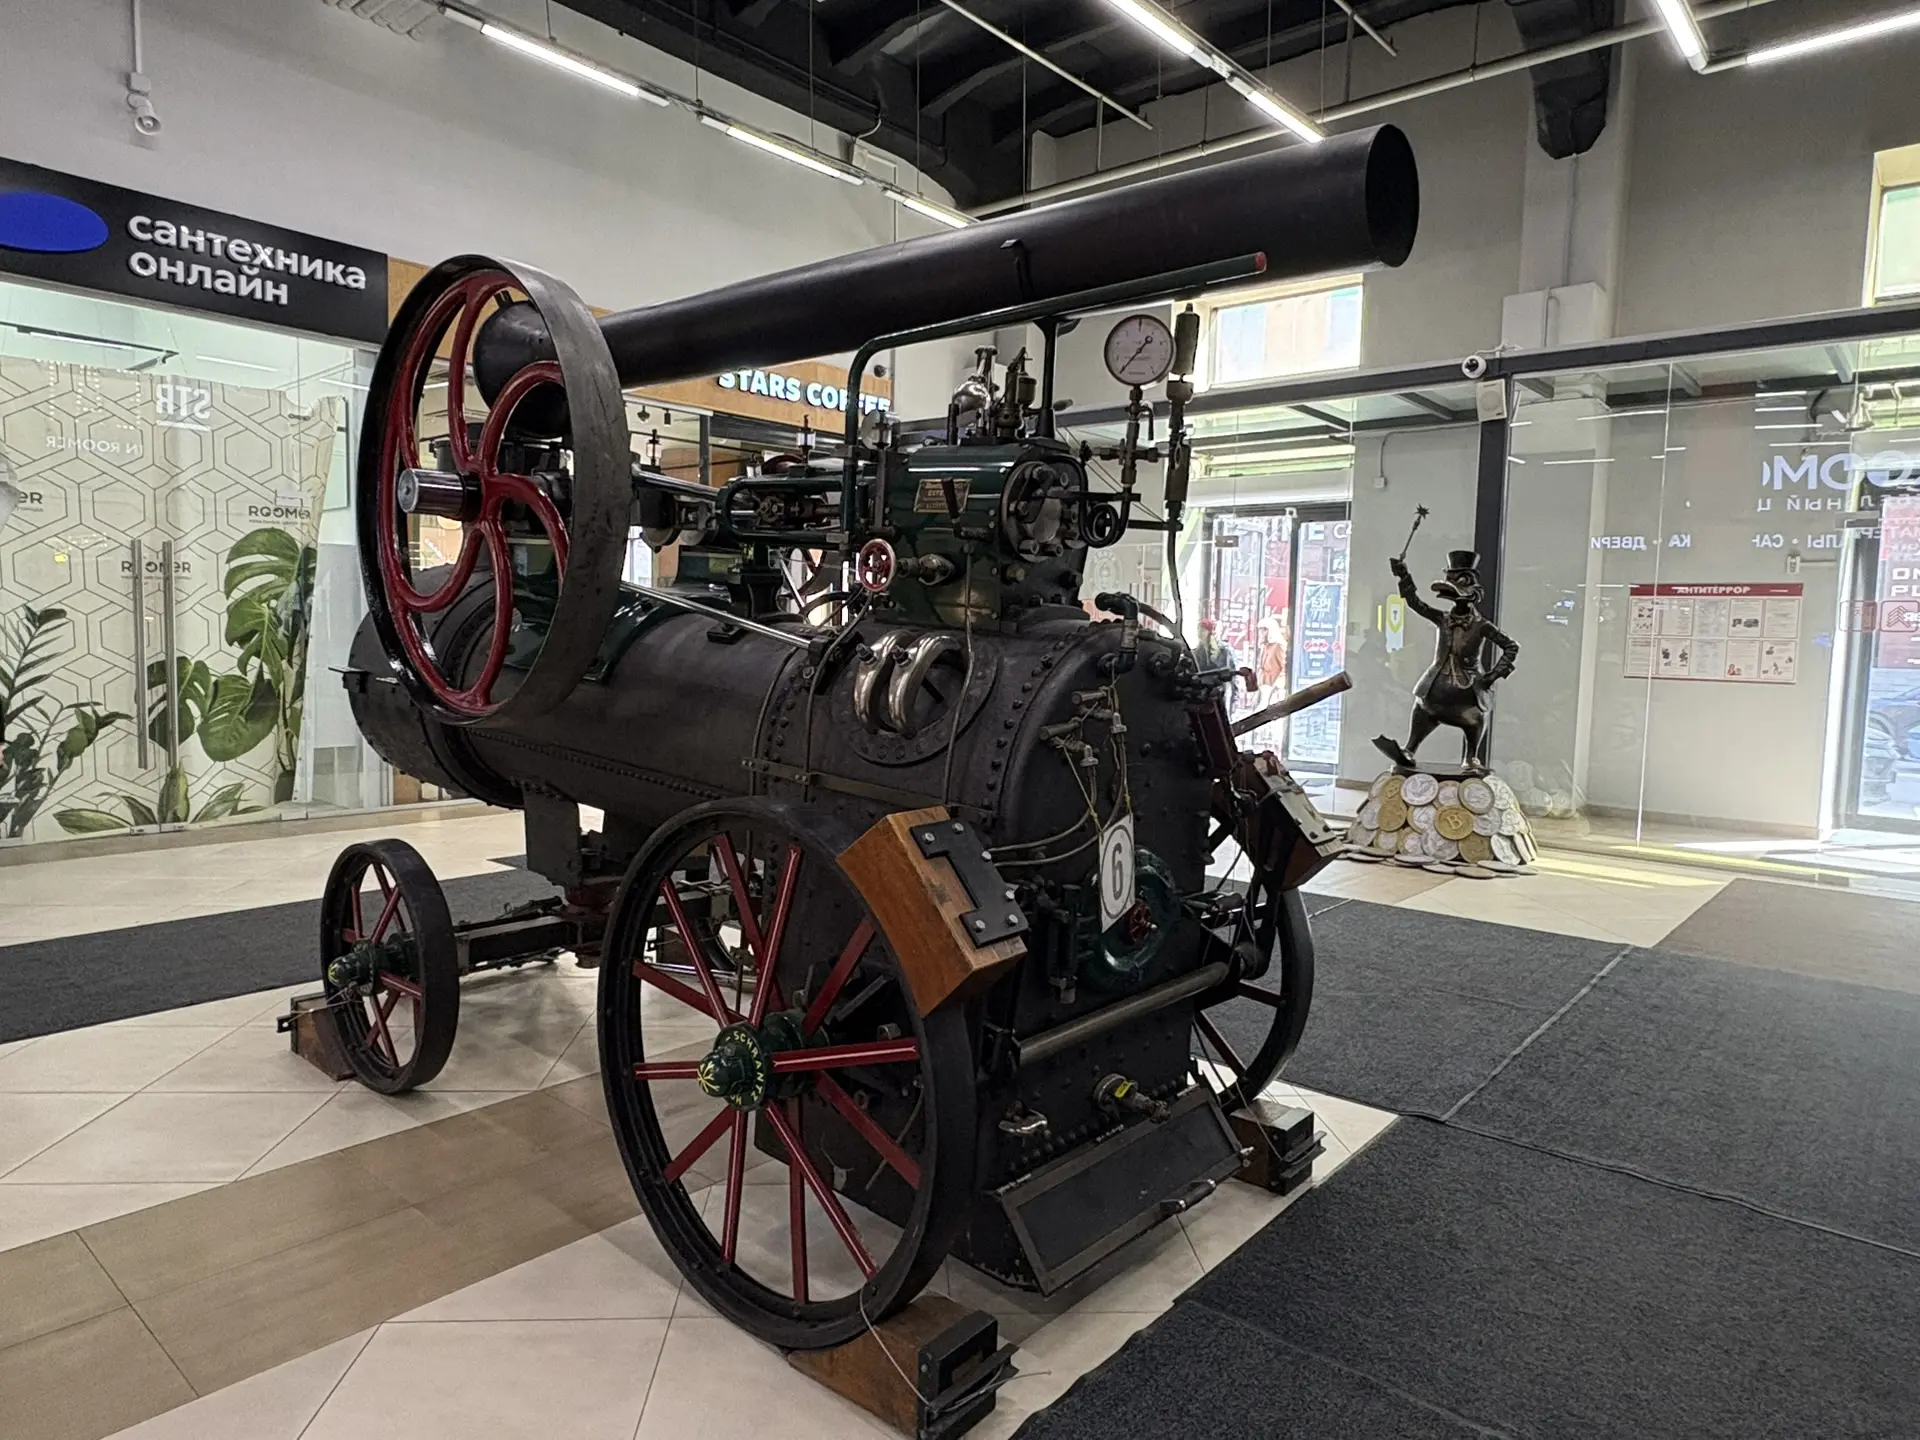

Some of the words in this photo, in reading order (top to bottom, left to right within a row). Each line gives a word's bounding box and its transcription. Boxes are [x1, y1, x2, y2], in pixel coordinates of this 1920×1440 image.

[127, 215, 366, 289] сантехника
[128, 251, 288, 305] онлайн
[1676, 586, 1752, 595] АНТИТЕРРОР
[1111, 842, 1124, 901] 6
